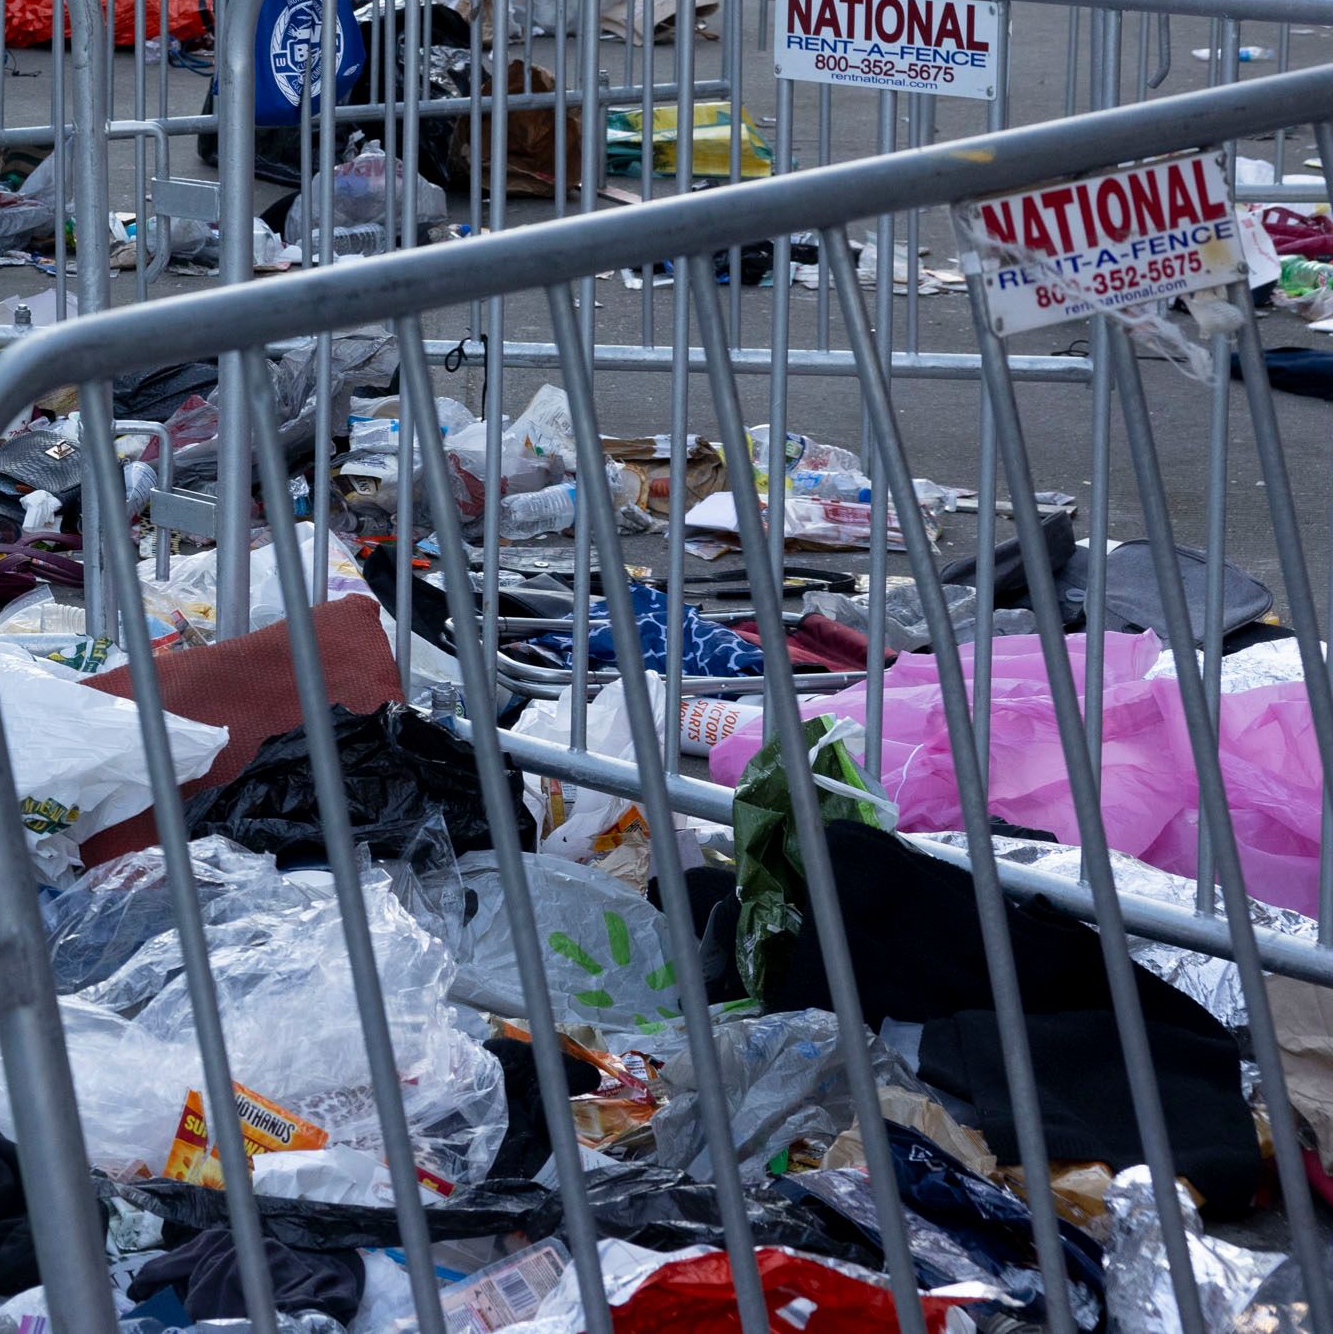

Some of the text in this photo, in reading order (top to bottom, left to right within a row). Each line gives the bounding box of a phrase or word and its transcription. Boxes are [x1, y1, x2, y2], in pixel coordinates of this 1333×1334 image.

[786, 35, 987, 68] RENT-A-FENCE
[814, 54, 954, 84] 800-352-5675
[830, 72, 939, 90] rentnational.com
[980, 159, 1228, 259] NATIONAL
[687, 699, 710, 743] STARTS
